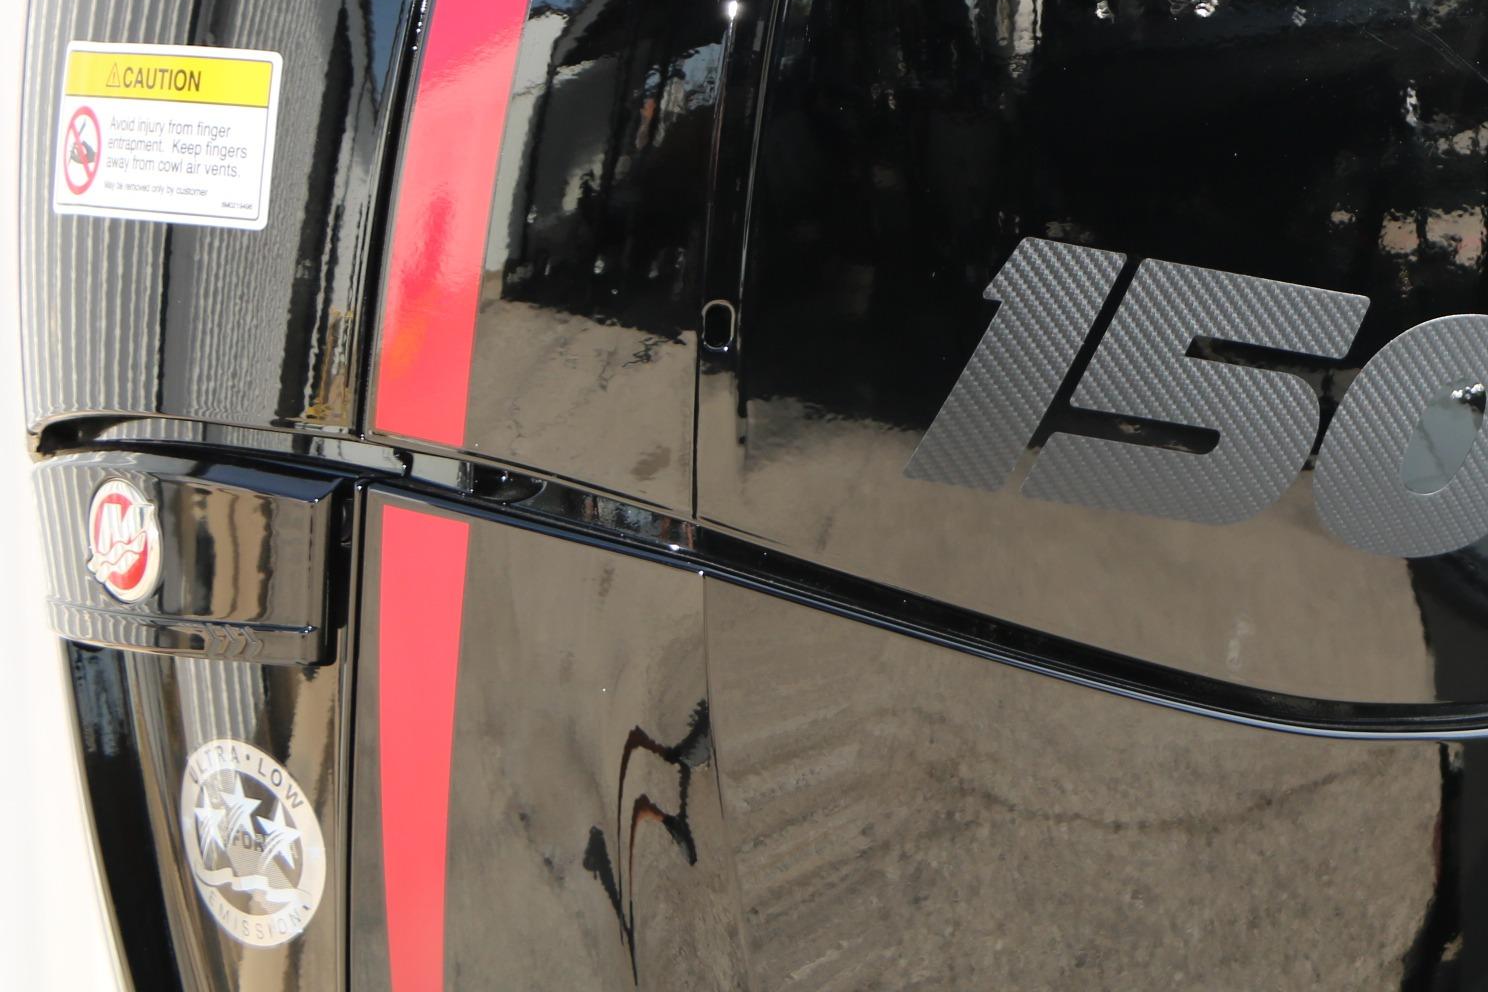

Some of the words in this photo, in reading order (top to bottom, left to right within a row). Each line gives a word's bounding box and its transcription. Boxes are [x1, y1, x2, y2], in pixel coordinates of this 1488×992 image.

[123, 67, 202, 92] CAUTION
[111, 115, 135, 132] Avoid
[137, 117, 164, 137] injury
[168, 120, 193, 135] from
[197, 121, 231, 141] finger
[172, 139, 202, 160] Keep
[206, 141, 248, 161] fingers
[106, 156, 128, 172] away
[132, 155, 155, 170] from
[158, 159, 183, 173] cowl
[186, 161, 201, 175] air
[205, 163, 241, 178] vents.
[189, 745, 240, 784] ULTRA
[257, 757, 304, 809] LOW
[207, 889, 302, 940] EMISSION
